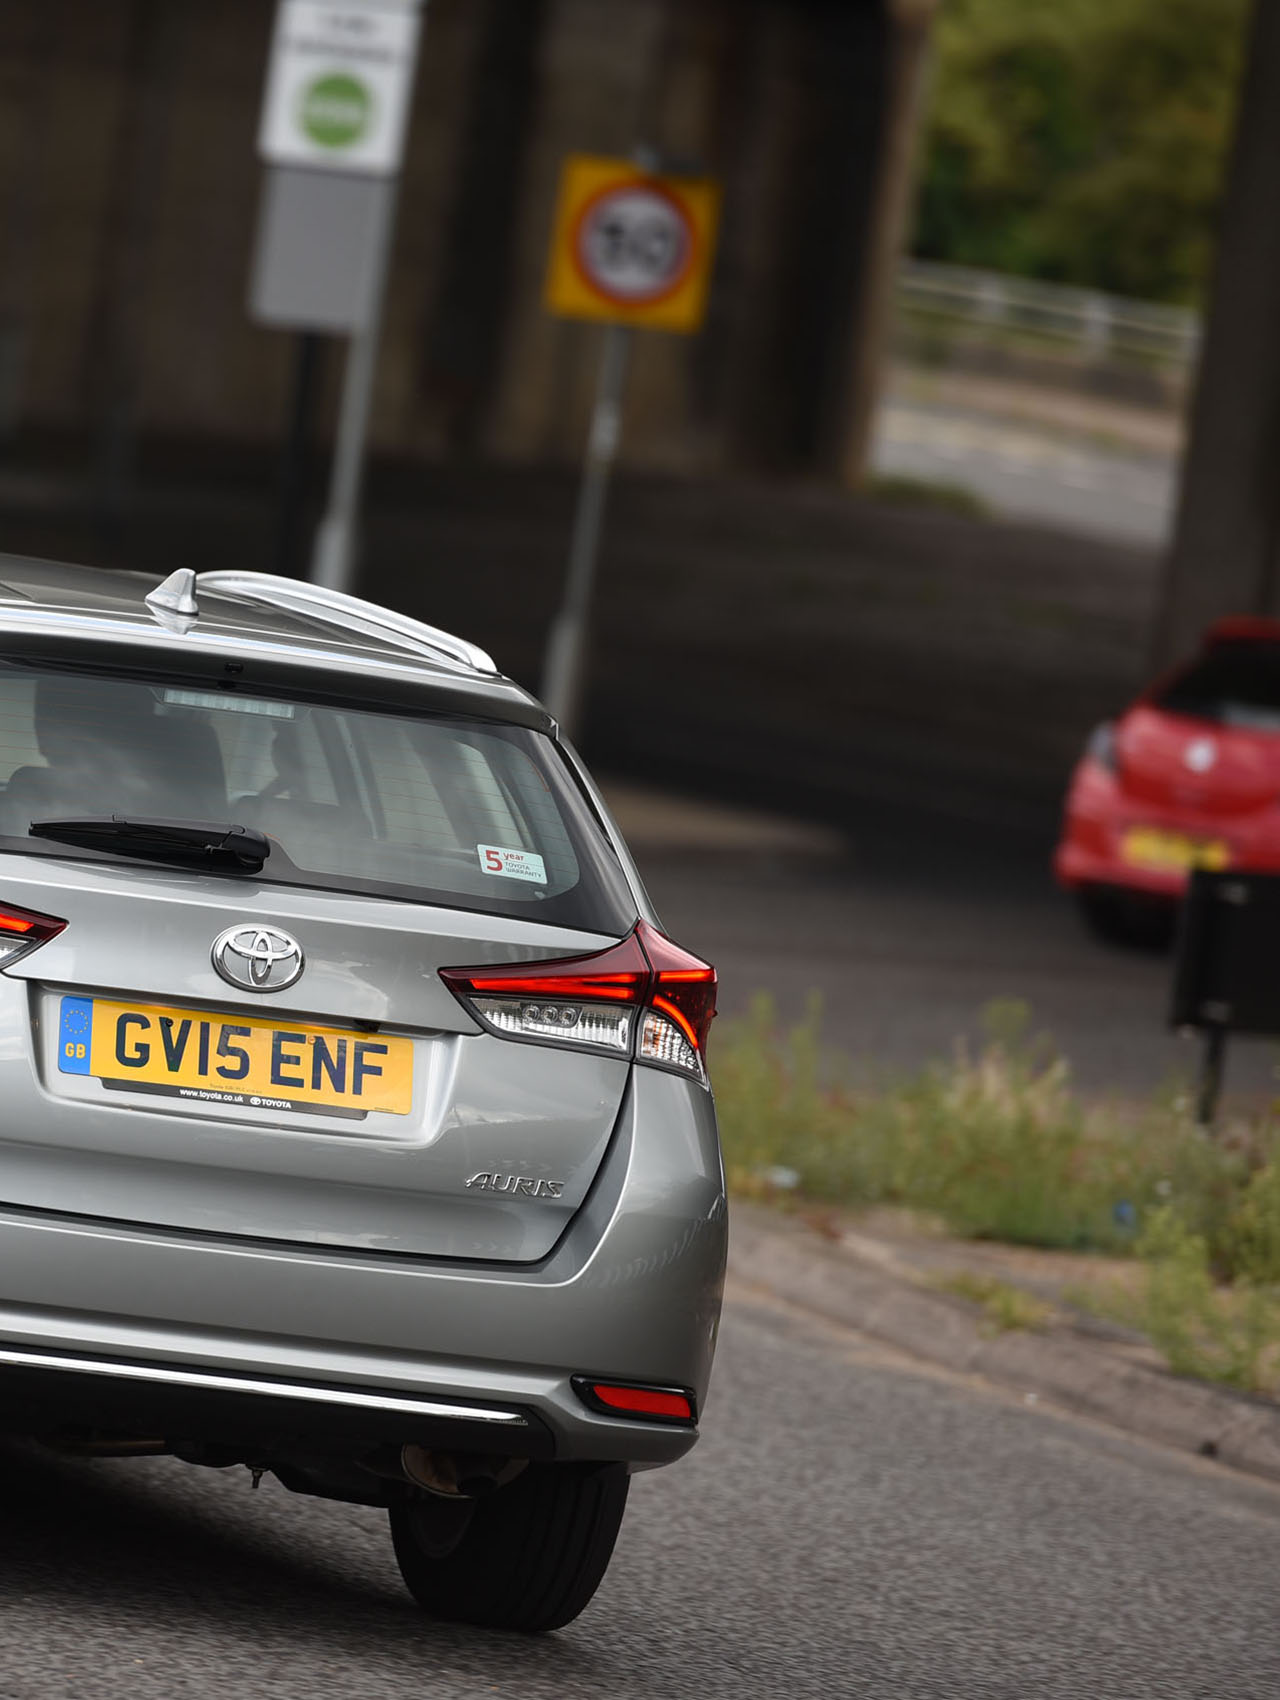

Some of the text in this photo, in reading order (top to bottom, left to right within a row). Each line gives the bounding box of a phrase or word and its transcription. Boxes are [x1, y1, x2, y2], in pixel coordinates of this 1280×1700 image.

[485, 849, 524, 871] 5 year
[505, 861, 530, 870] TOYOTA
[505, 868, 542, 877] WARRANTY
[65, 1042, 86, 1059] GB
[115, 1012, 388, 1096] GV15 ENF
[179, 1088, 244, 1103] www.toyota.co.uk
[261, 1098, 291, 1109] TOYOTA
[465, 1171, 565, 1198] AURIS
